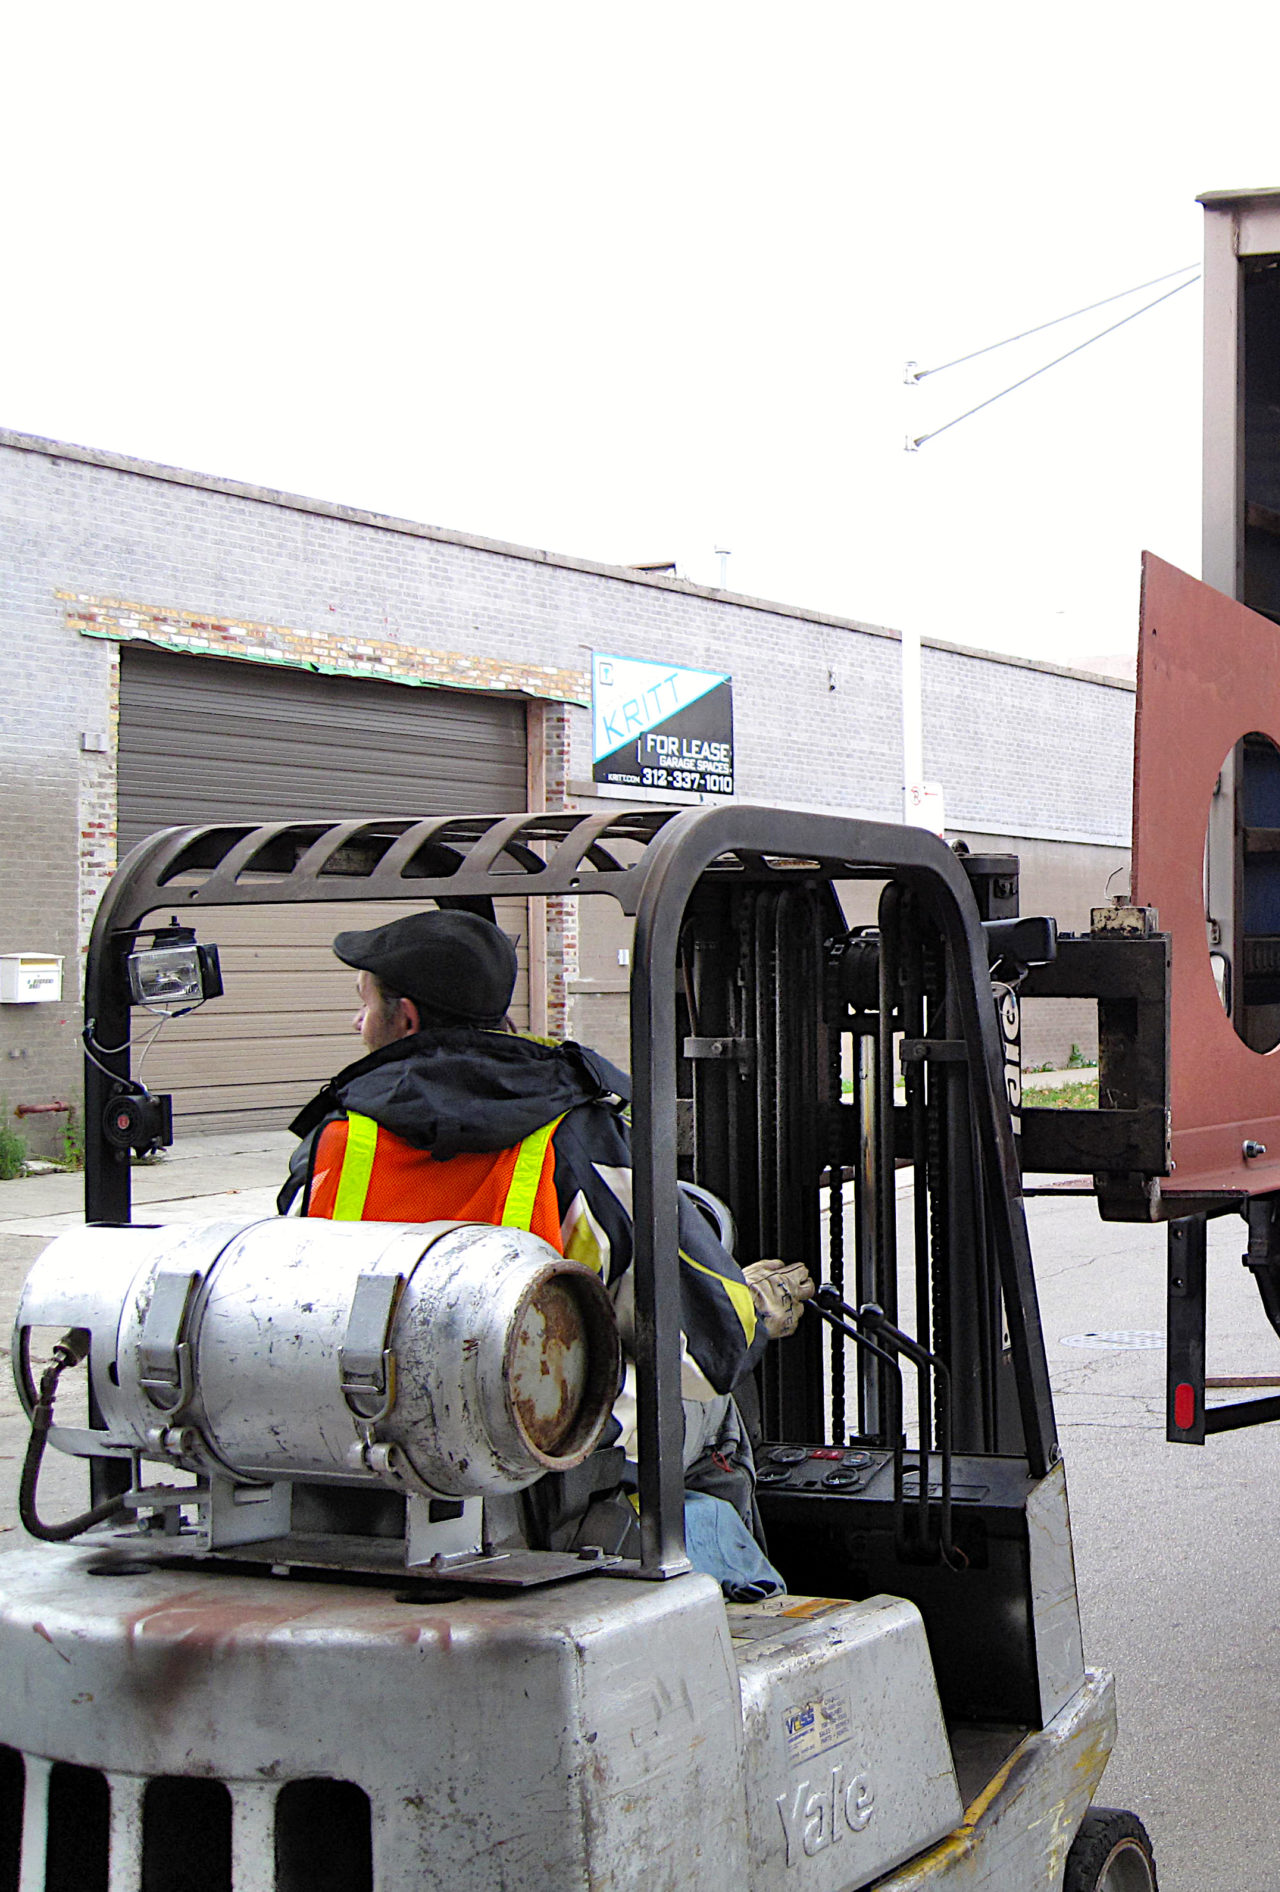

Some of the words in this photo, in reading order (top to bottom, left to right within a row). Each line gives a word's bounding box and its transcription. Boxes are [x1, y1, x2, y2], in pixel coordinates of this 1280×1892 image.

[603, 673, 678, 745] KRITT
[646, 733, 680, 756] FOR
[682, 738, 730, 763] LEASE
[659, 755, 697, 770] GARAGE
[697, 759, 730, 774] SPACES
[642, 767, 733, 793] 312-337-1010
[776, 1763, 875, 1869] Yale
